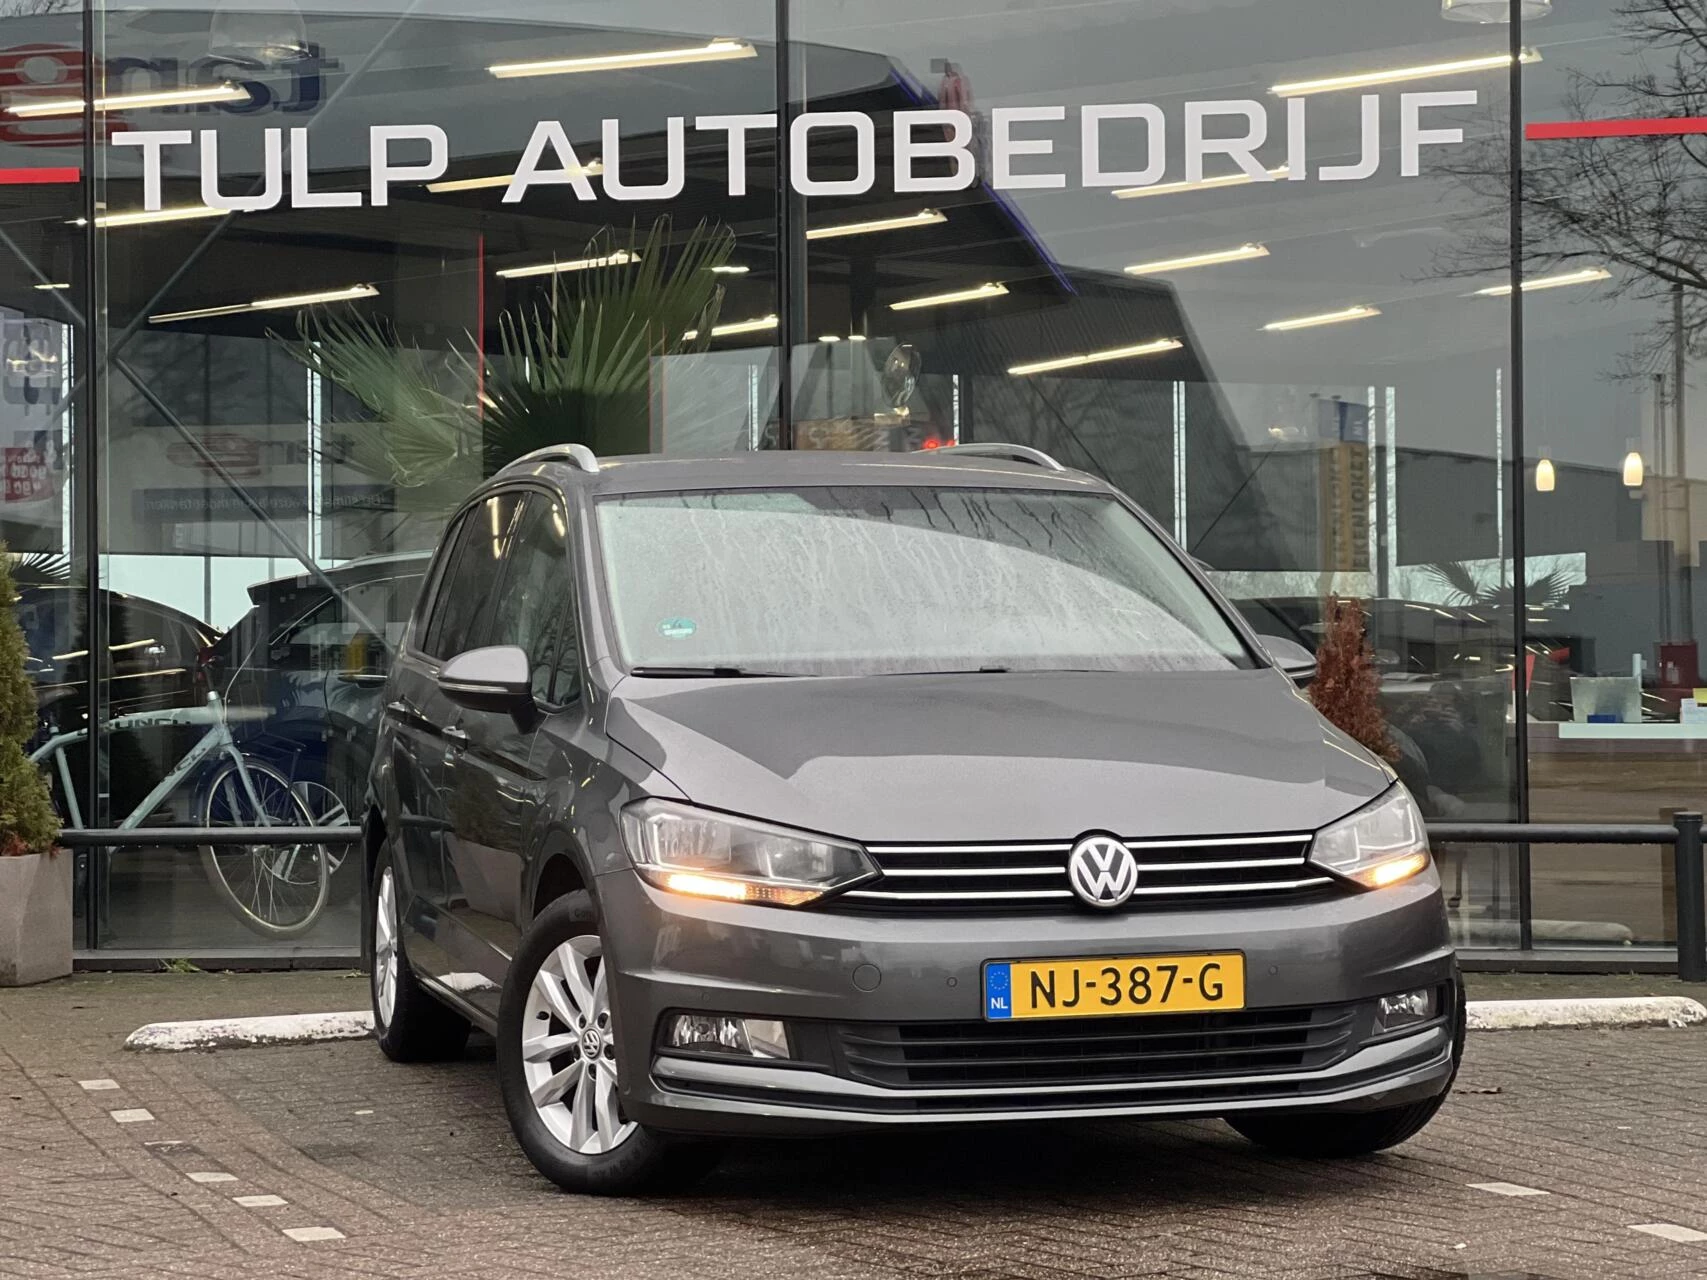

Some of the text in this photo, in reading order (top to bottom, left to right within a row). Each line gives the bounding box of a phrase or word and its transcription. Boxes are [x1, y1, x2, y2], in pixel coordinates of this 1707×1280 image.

[112, 90, 1477, 211] TULP AUTOBEDRIJF
[991, 998, 1008, 1010] NL
[1030, 963, 1223, 1009] NJ-387-G
